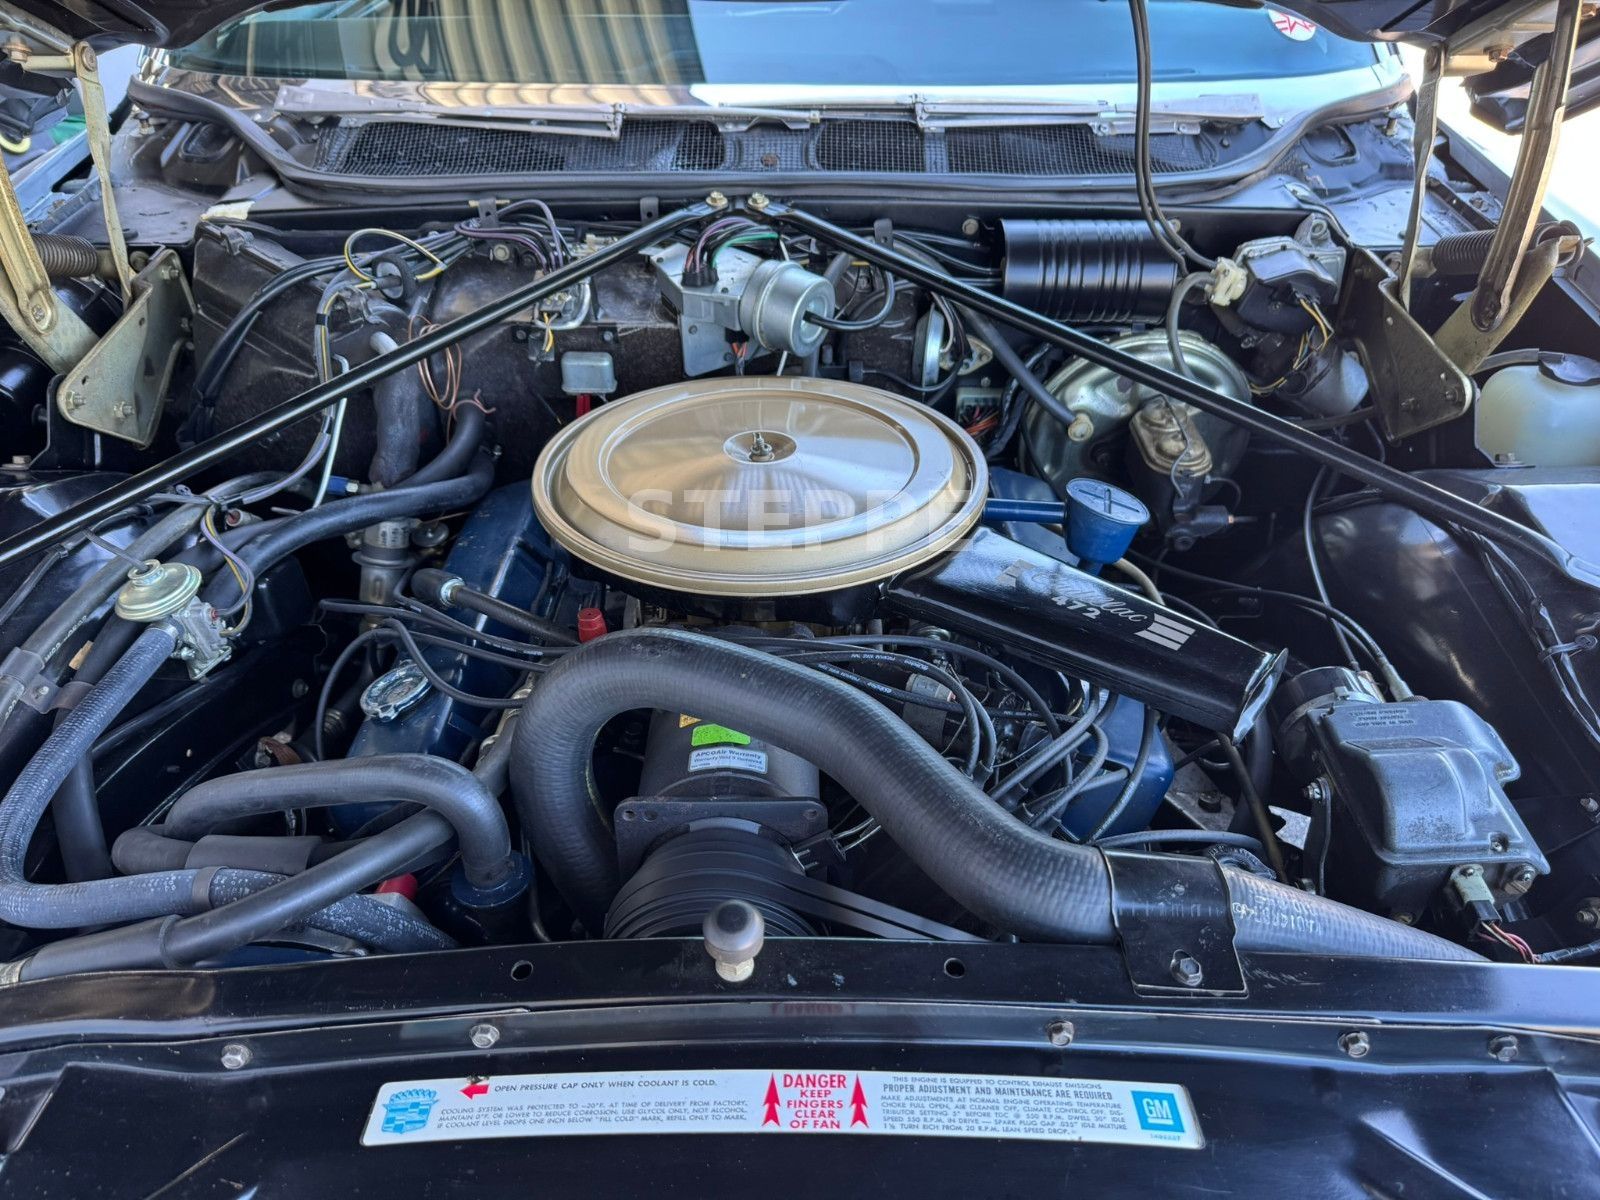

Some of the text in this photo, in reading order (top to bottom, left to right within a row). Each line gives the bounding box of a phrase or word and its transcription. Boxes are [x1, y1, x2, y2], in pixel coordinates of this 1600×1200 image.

[1051, 596, 1101, 620] 472
[729, 749, 762, 760] Warranty
[494, 1084, 517, 1092] OPEN
[519, 1083, 558, 1091] PRESSURE
[608, 1080, 634, 1088] WHEN
[783, 1073, 848, 1089] DANGER
[950, 1077, 983, 1085] EQUIPPED
[1033, 1080, 1062, 1088] EXHAUST
[800, 1089, 832, 1098] KEEP
[883, 1084, 1113, 1100] PROPER ADJUSTMENT AND MAINTENANCE ARE REQUIRED
[787, 1100, 844, 1109] FINGERS
[1033, 1099, 1073, 1107] OPERATING
[1076, 1101, 1122, 1110] TEMPERATURE
[1142, 1097, 1173, 1120] GM
[441, 1107, 474, 1115] COOLING
[794, 1110, 836, 1119] CLEAR
[1054, 1107, 1088, 1115] CONTROL
[438, 1114, 473, 1122] MAINTAIN
[445, 1120, 480, 1128] COOLANT
[503, 1118, 527, 1126] DROPS
[789, 1120, 841, 1130] OF FAN
[1098, 1123, 1128, 1131] MIXTURE
